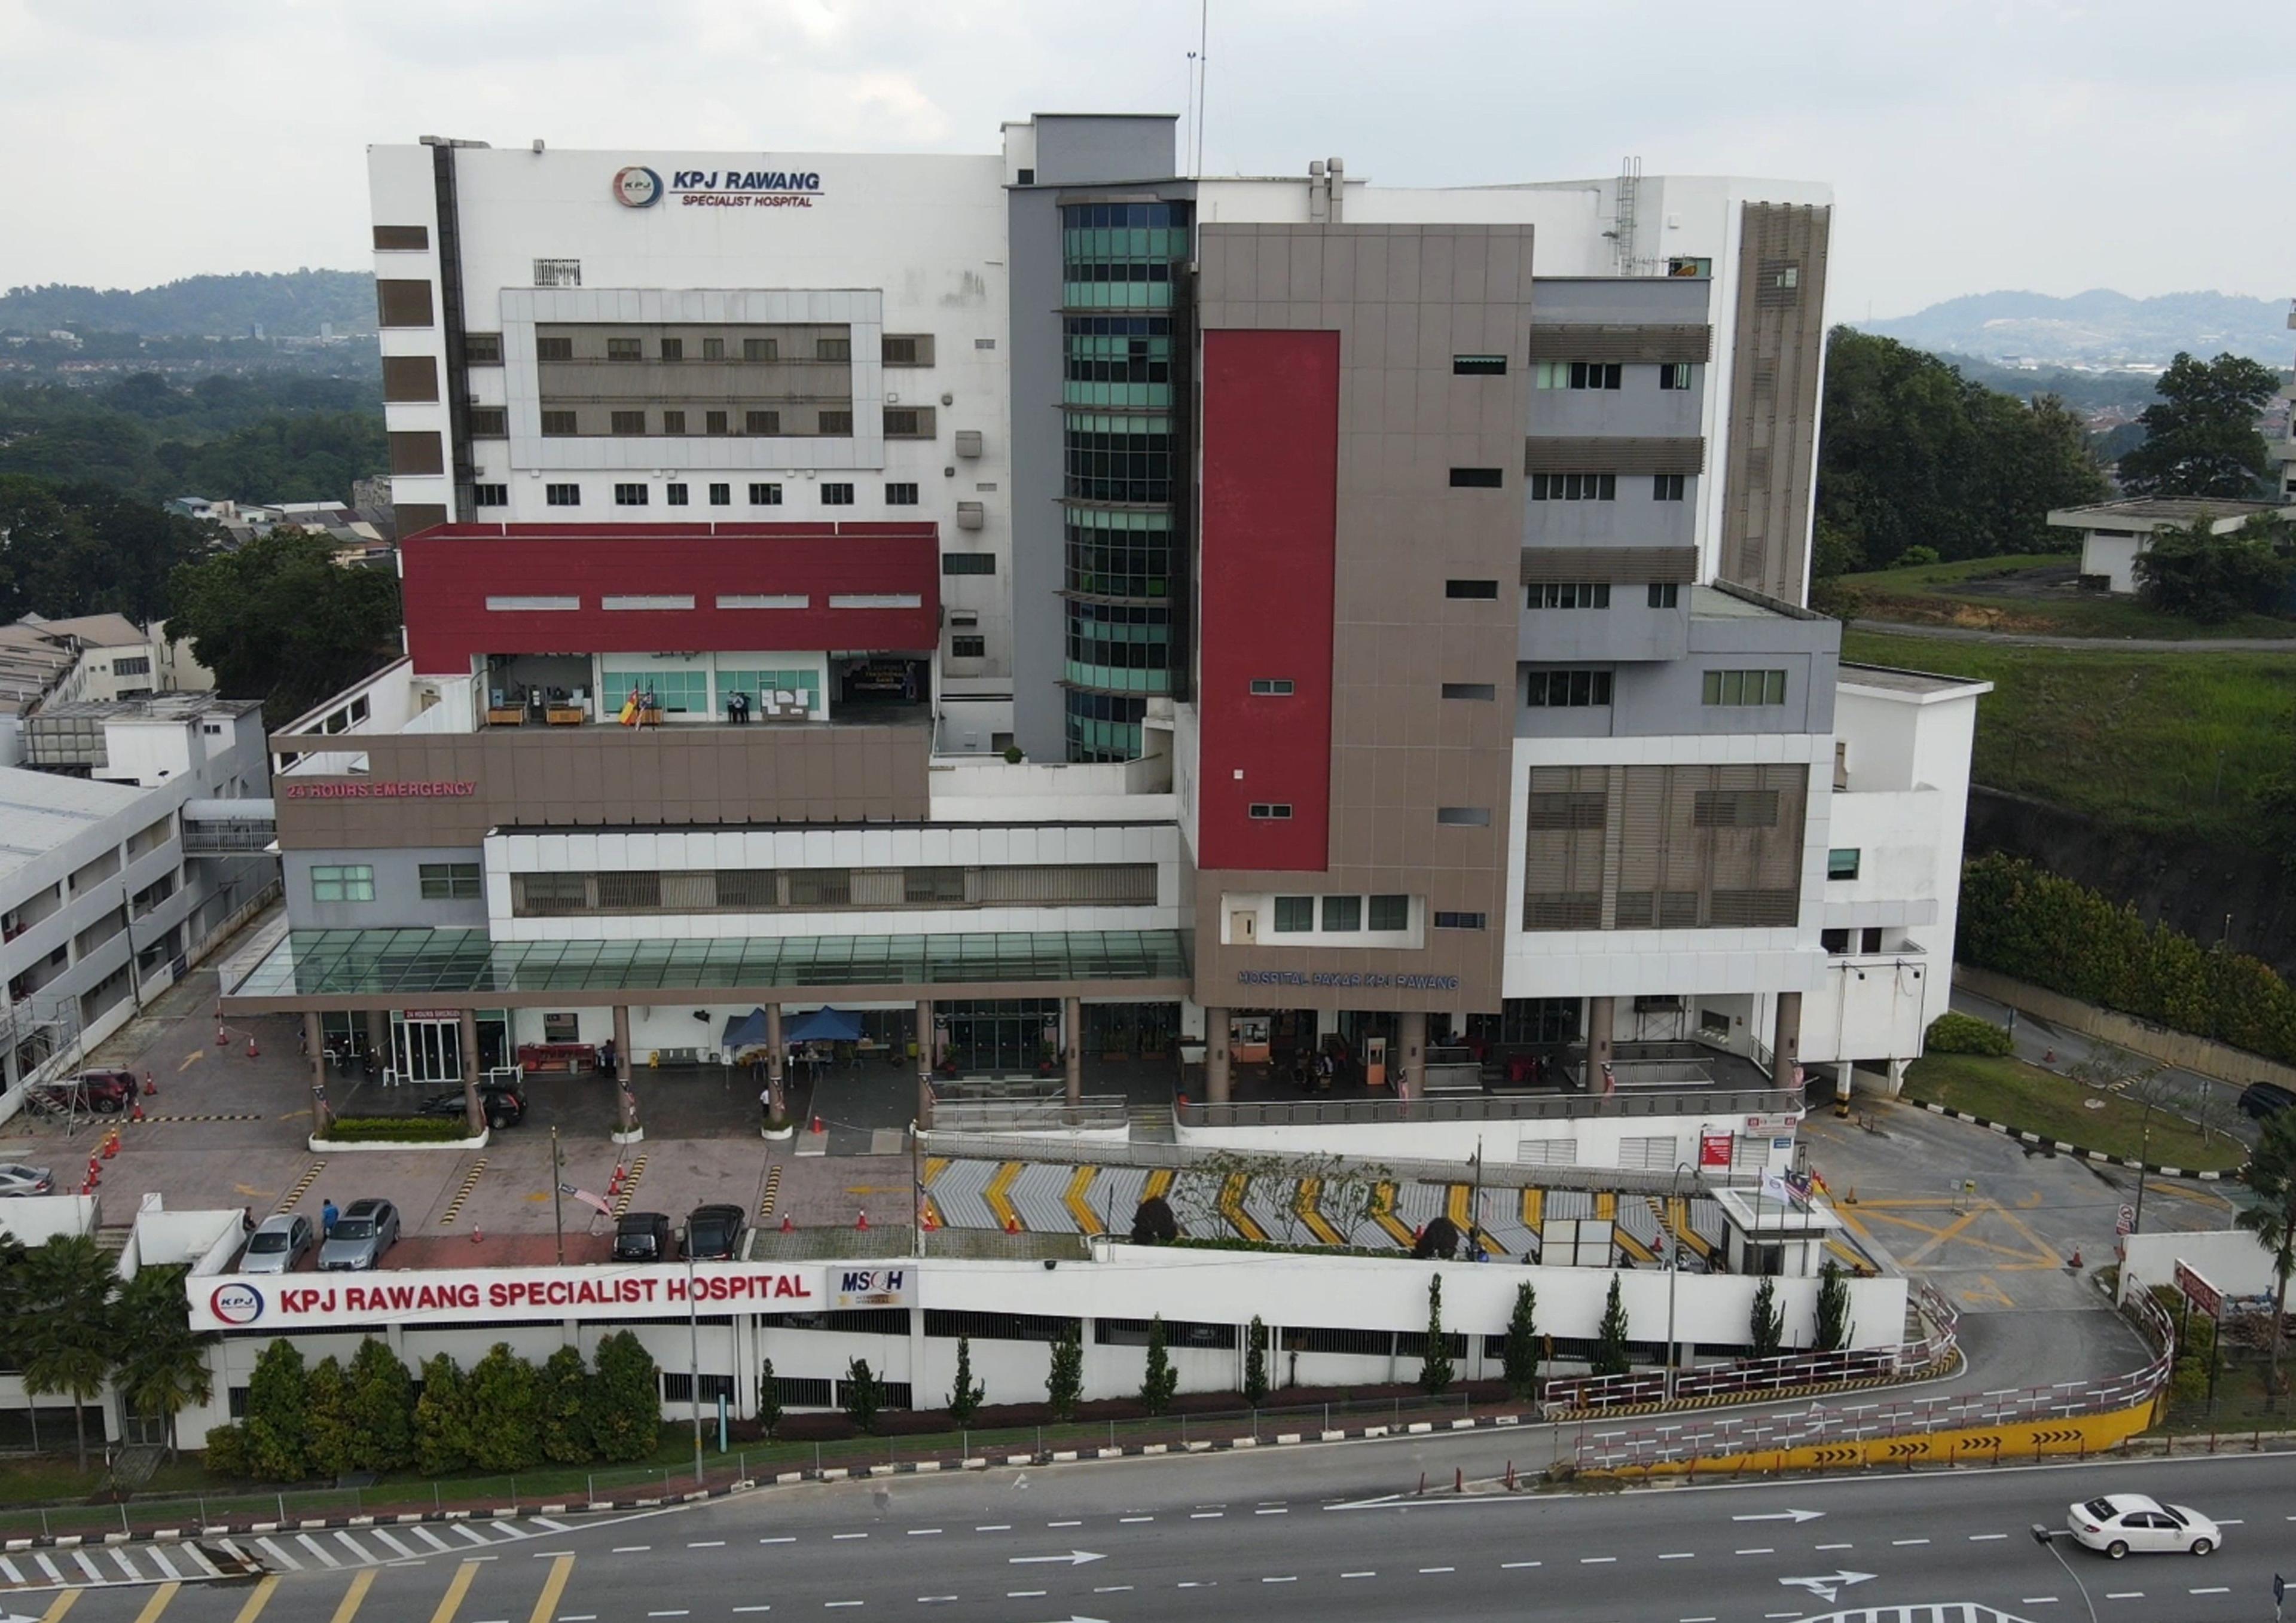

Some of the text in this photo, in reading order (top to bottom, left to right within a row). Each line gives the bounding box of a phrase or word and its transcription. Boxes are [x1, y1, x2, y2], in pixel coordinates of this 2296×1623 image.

[673, 171, 820, 190] KPJ RAWANG
[682, 195, 813, 207] SPECIALIST HOSPITAL
[287, 781, 477, 798] 24 HOURS EMERGENCY
[1238, 970, 1460, 990] HOSPITAL PAKAR KPJ RAWANG
[841, 1270, 903, 1293] MSQH
[221, 1297, 254, 1306] KPJ
[280, 1275, 811, 1313] KPJ RAWANG SPECIALIST HOSPITAL
